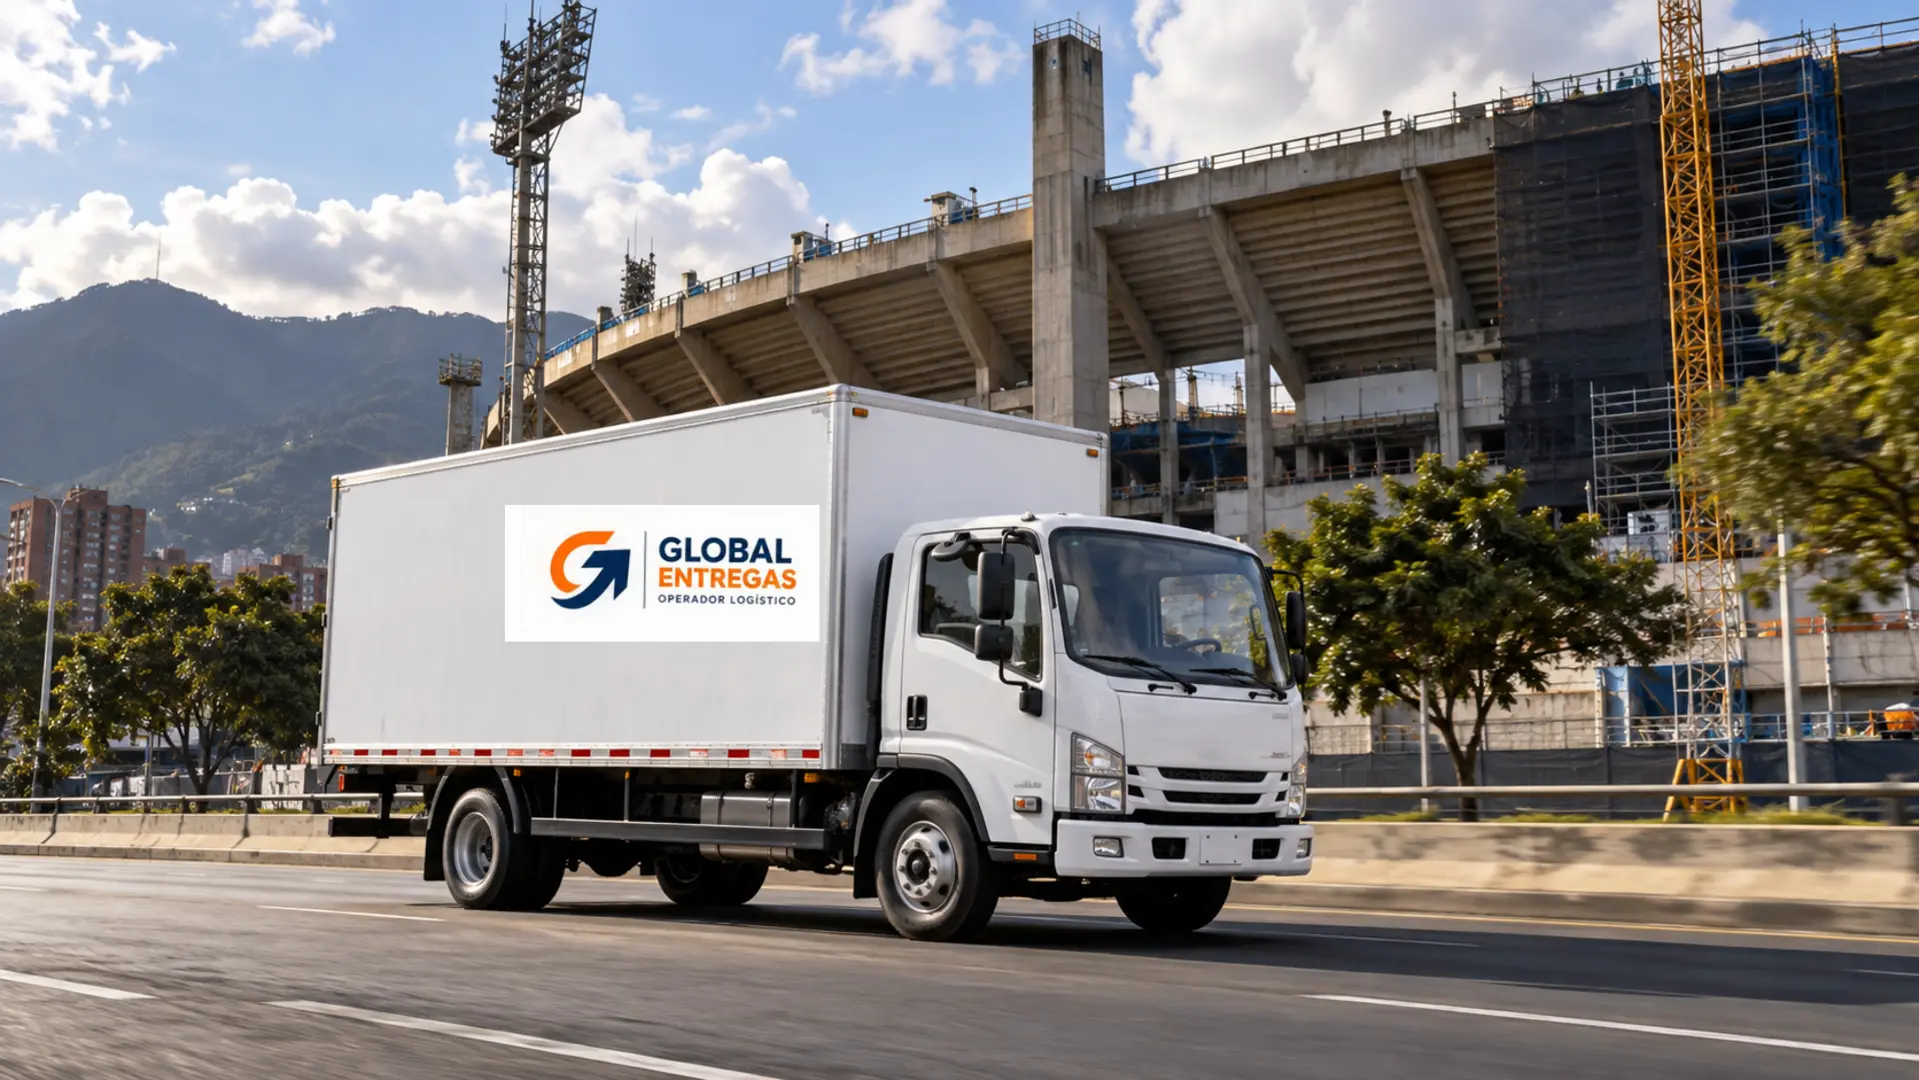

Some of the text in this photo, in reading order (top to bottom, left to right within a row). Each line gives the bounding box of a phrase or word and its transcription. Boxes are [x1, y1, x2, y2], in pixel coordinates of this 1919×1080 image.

[658, 536, 793, 564] GLOBAL
[658, 567, 797, 590] ENTREGAS
[657, 594, 796, 606] OPERADOR LOGÍSTICO
